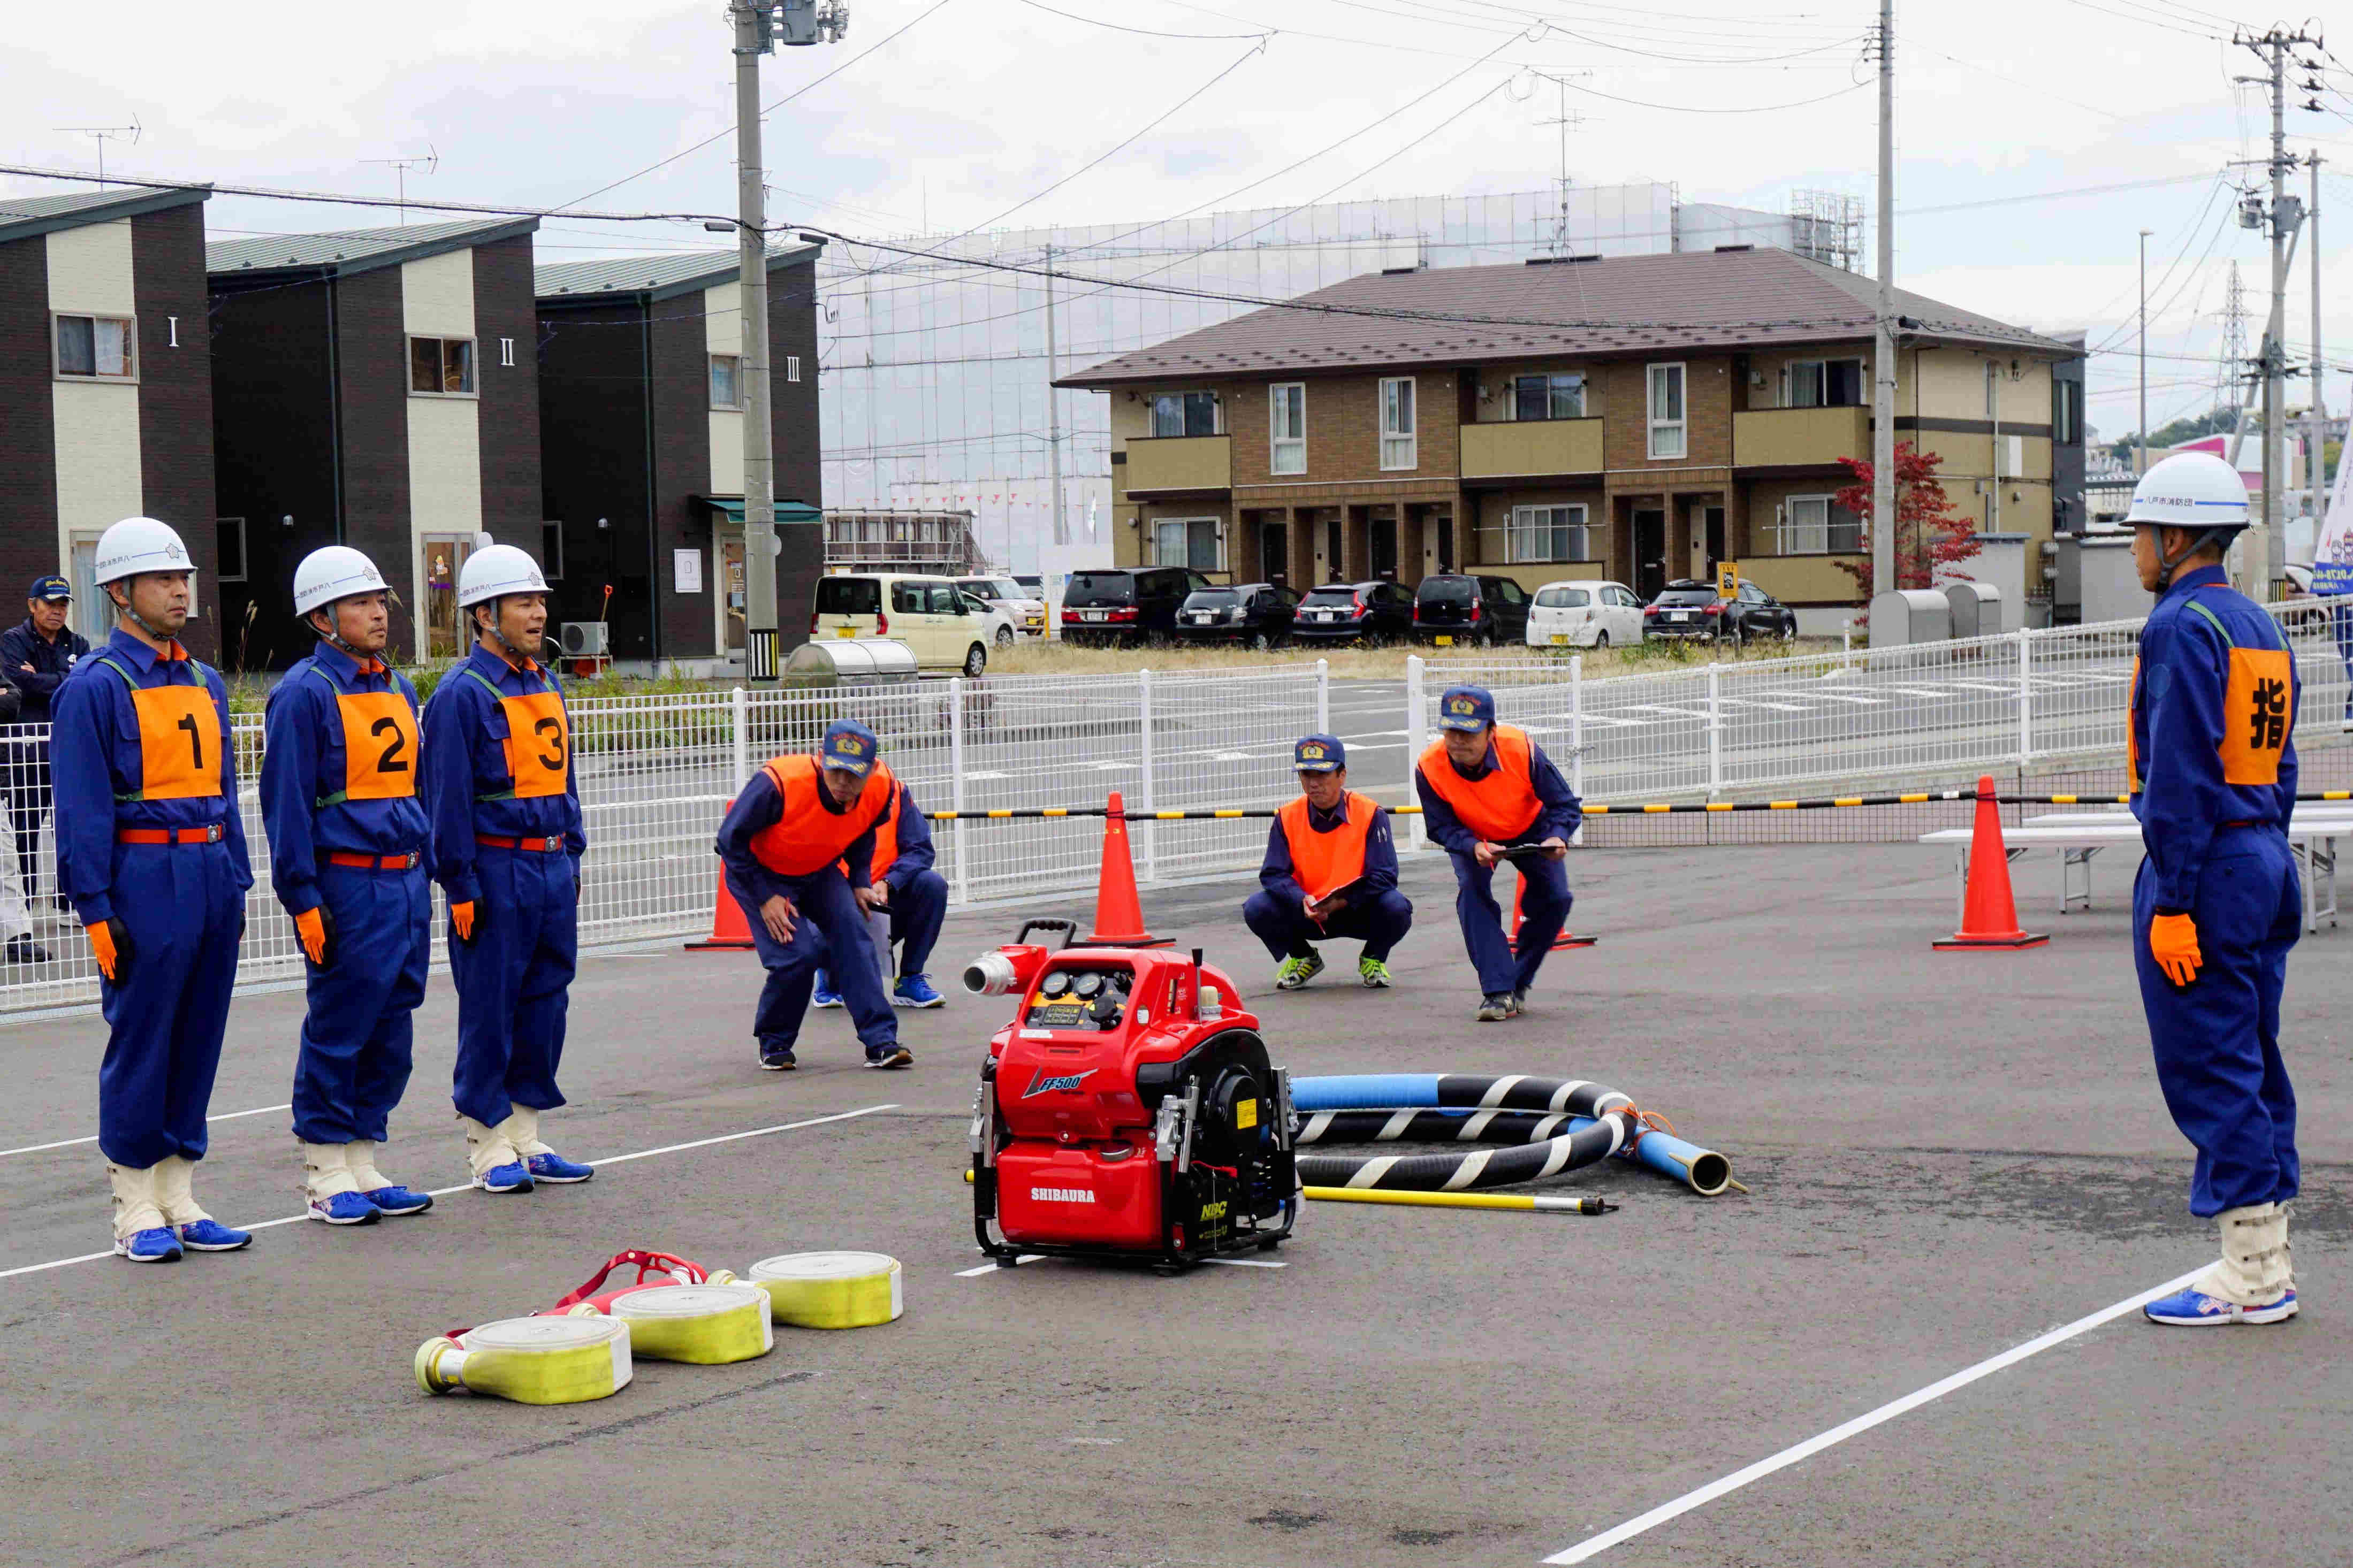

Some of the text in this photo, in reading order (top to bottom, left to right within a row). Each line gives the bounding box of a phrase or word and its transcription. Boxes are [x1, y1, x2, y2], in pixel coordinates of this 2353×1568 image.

[499, 338, 515, 366] II
[786, 356, 801, 382] III
[2145, 496, 2193, 507] 八戸市消防団
[2250, 677, 2286, 749] 指
[178, 714, 203, 769] 1
[371, 716, 408, 772] 2
[534, 717, 565, 771] 3
[1031, 1187, 1095, 1203] SHIBAURA
